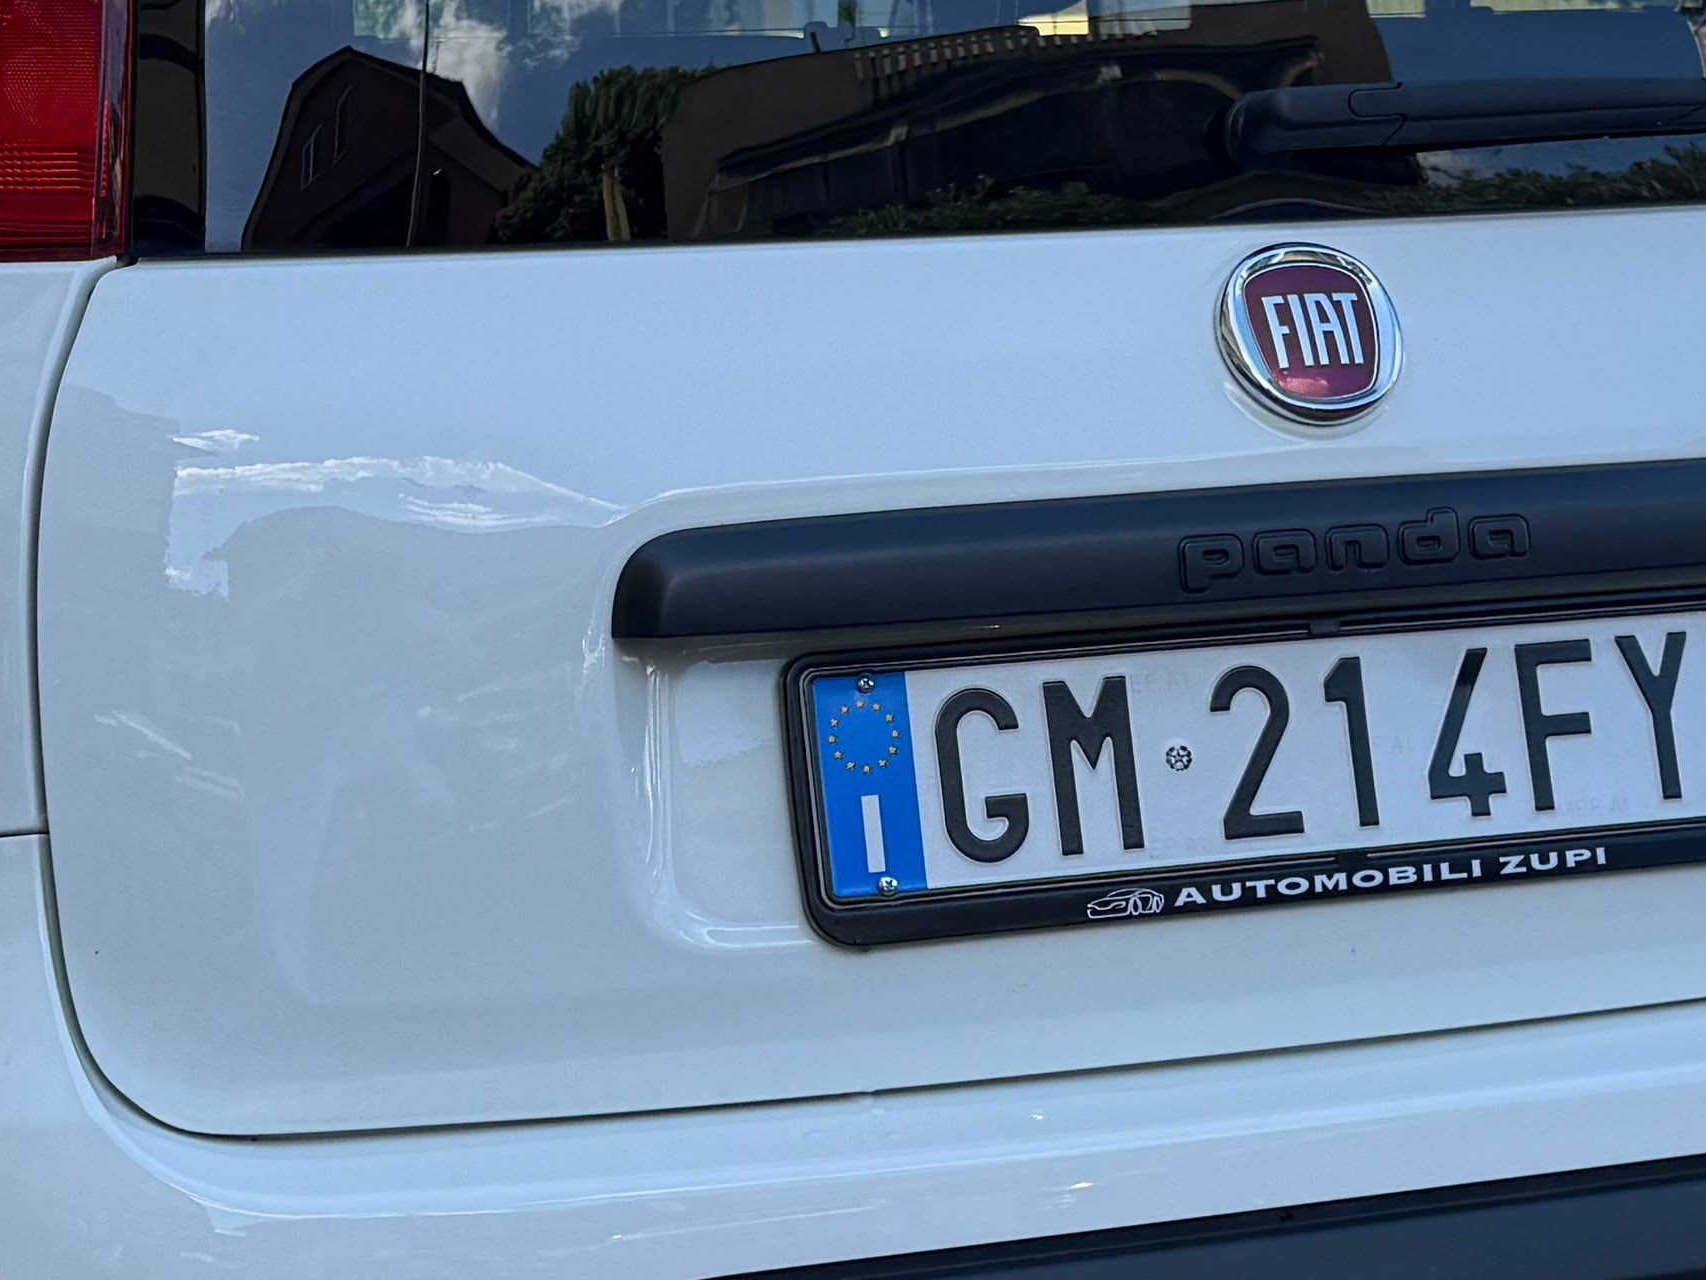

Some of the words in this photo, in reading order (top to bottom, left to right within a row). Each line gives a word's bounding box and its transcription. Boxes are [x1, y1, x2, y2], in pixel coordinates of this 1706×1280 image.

[1261, 292, 1364, 368] FIAT
[1179, 506, 1531, 594] panda
[934, 674, 1146, 864] GM
[1208, 630, 1688, 841] 214FY
[1174, 859, 1482, 907] AUTOMOBILI
[1499, 847, 1607, 876] ZUPI
